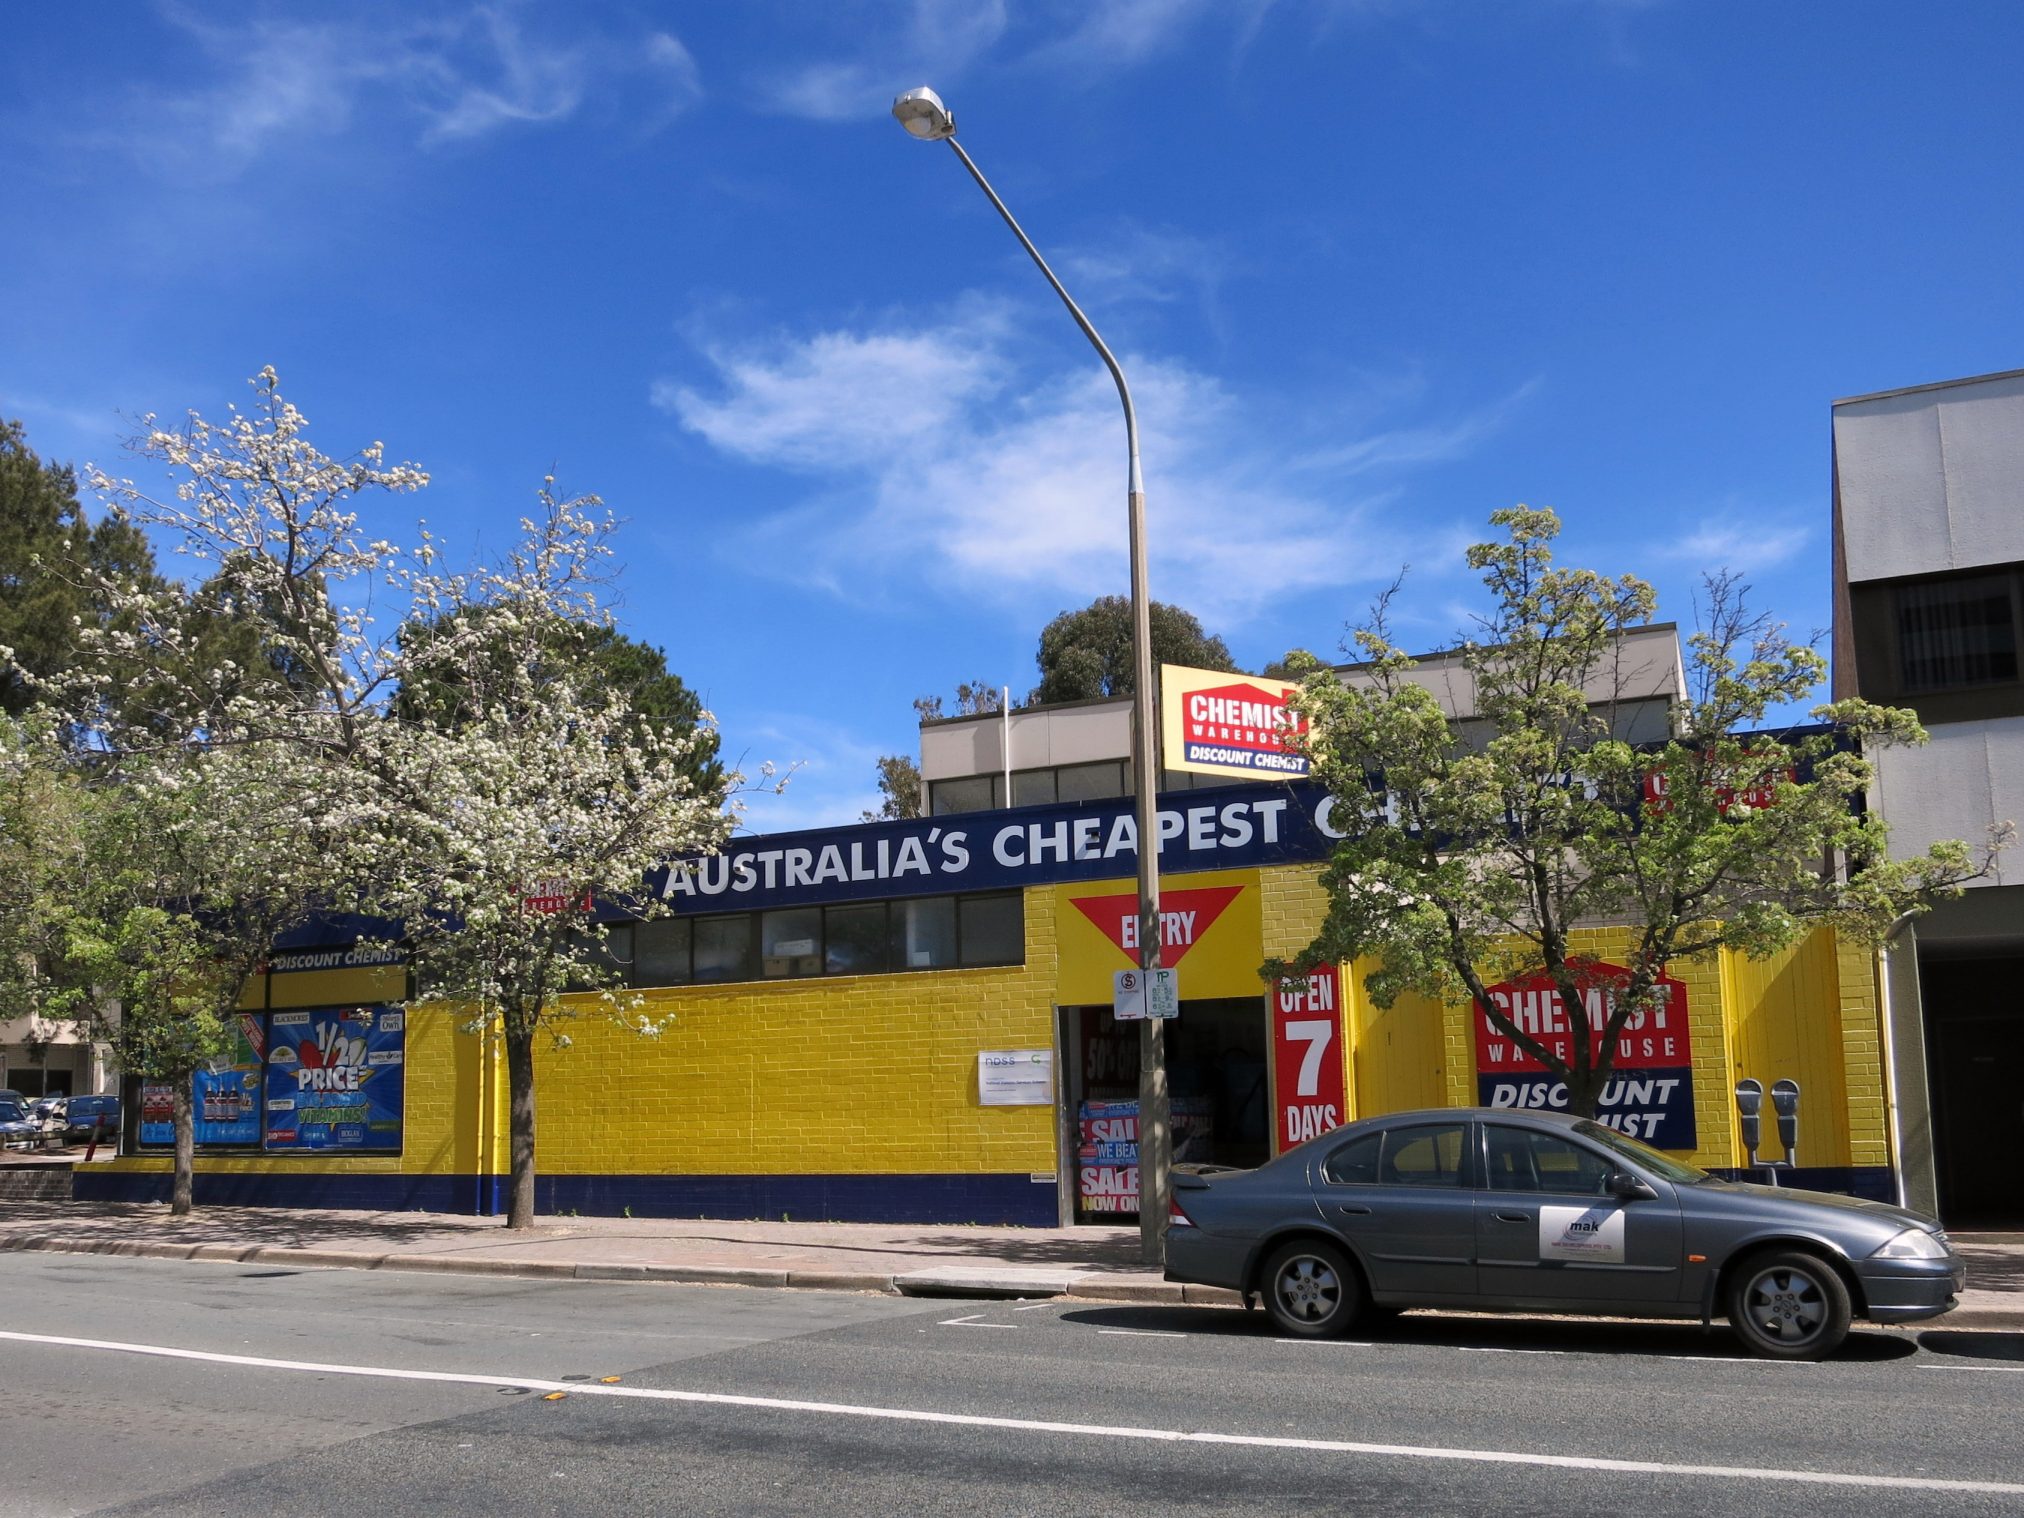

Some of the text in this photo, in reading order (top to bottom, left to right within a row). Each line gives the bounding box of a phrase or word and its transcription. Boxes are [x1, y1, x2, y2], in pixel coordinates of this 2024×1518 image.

[1190, 695, 1300, 732] CHEMIST
[1192, 723, 1286, 745] WAREHOU
[1190, 745, 1306, 771] DISCOUNT CHEMIST
[662, 827, 970, 898] AUSTRALIA'S
[992, 799, 1287, 867] CHEAPEST
[277, 949, 400, 971] DISCOUNT CHEMIST
[1280, 974, 1333, 1013] OPEN
[1285, 1019, 1333, 1097] 7
[1488, 1037, 1675, 1062] WAEUSE
[298, 1066, 359, 1090] PRICE
[1491, 1079, 1680, 1108] DISCUNT
[1287, 1104, 1337, 1142] DAYS
[1097, 1143, 1113, 1158] WE
[1116, 1143, 1139, 1158] BEA
[1081, 1167, 1139, 1195] SALE
[1082, 1195, 1140, 1212] NOW ON
[1569, 1221, 1600, 1232] mak
